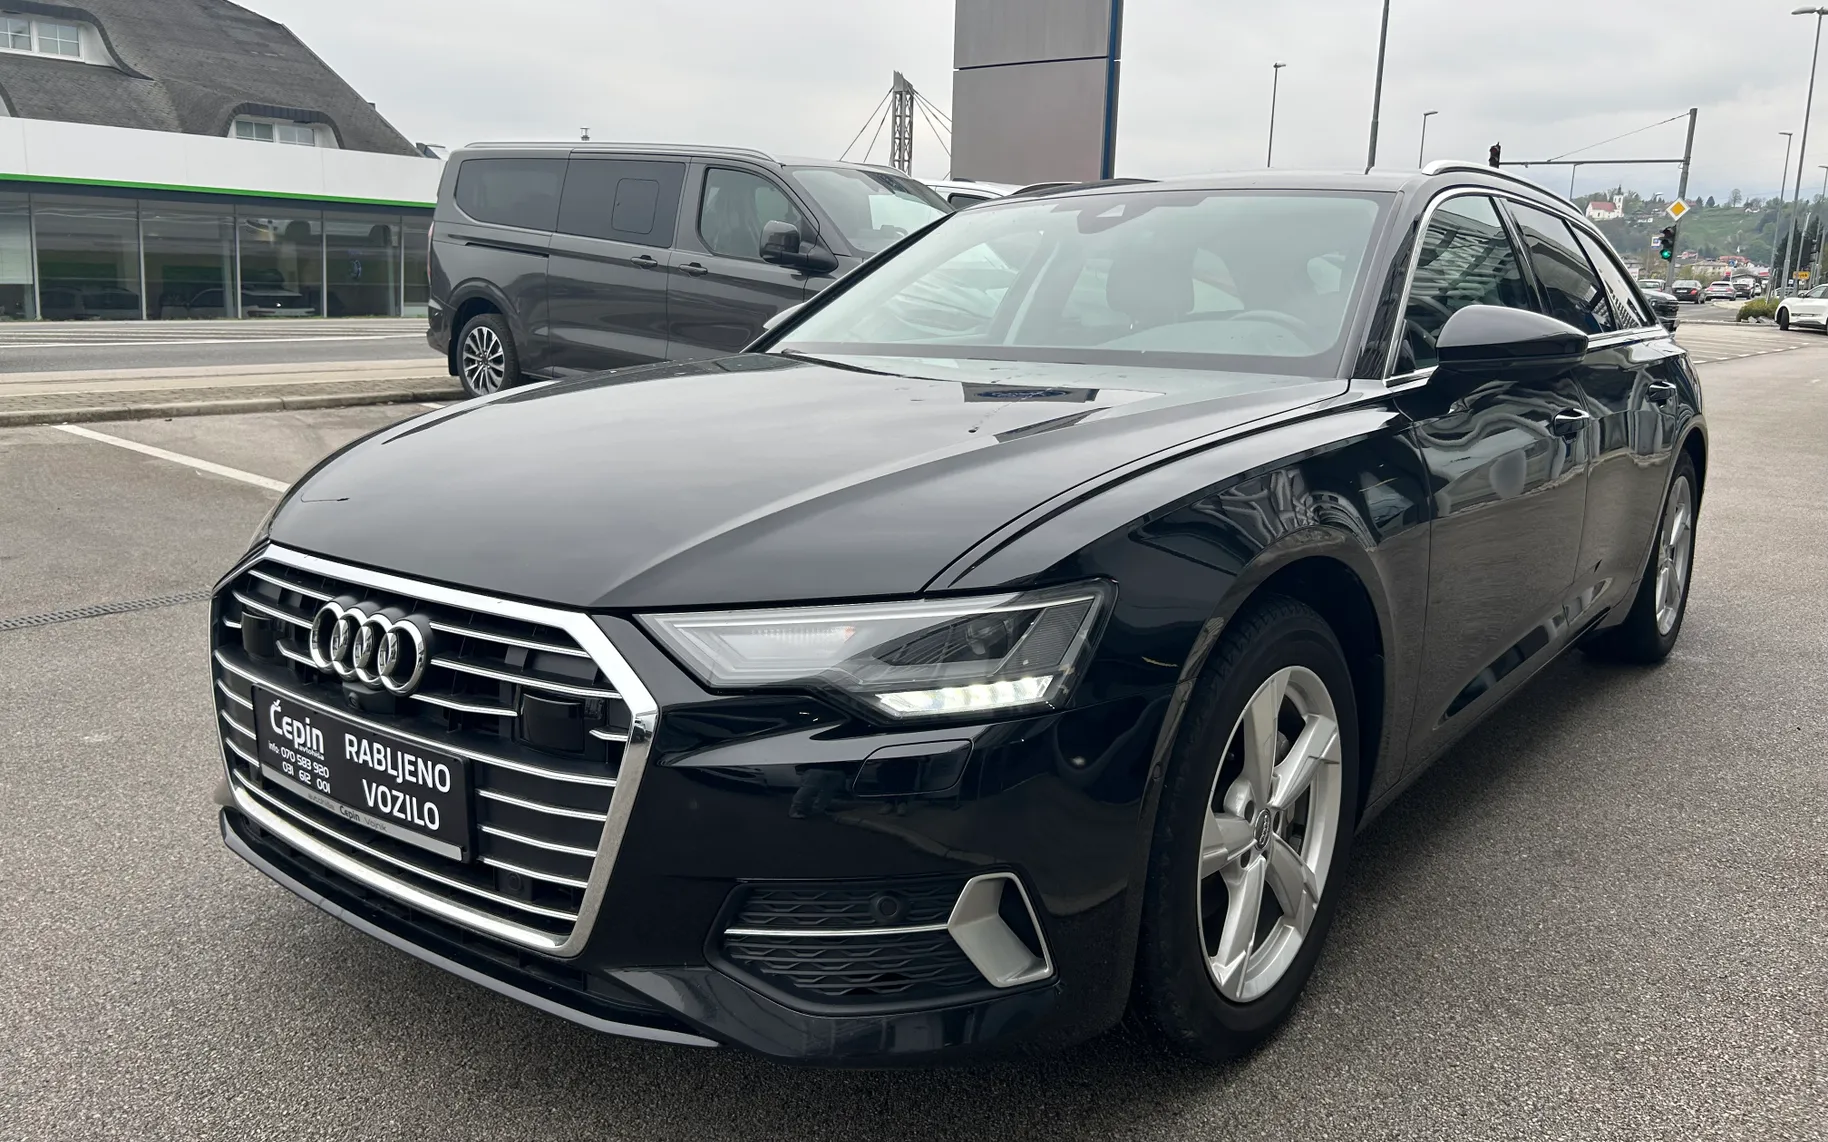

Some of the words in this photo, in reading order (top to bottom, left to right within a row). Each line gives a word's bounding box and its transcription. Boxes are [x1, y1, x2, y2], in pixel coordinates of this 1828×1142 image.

[269, 698, 324, 754] Čepin
[280, 746, 296, 763] 070
[296, 754, 312, 771] 583
[313, 762, 330, 779] 920
[282, 761, 295, 776] 031
[298, 769, 312, 785] 612
[316, 778, 331, 794] 001
[344, 732, 451, 793] RABLJENO
[362, 778, 440, 831] VOZILO
